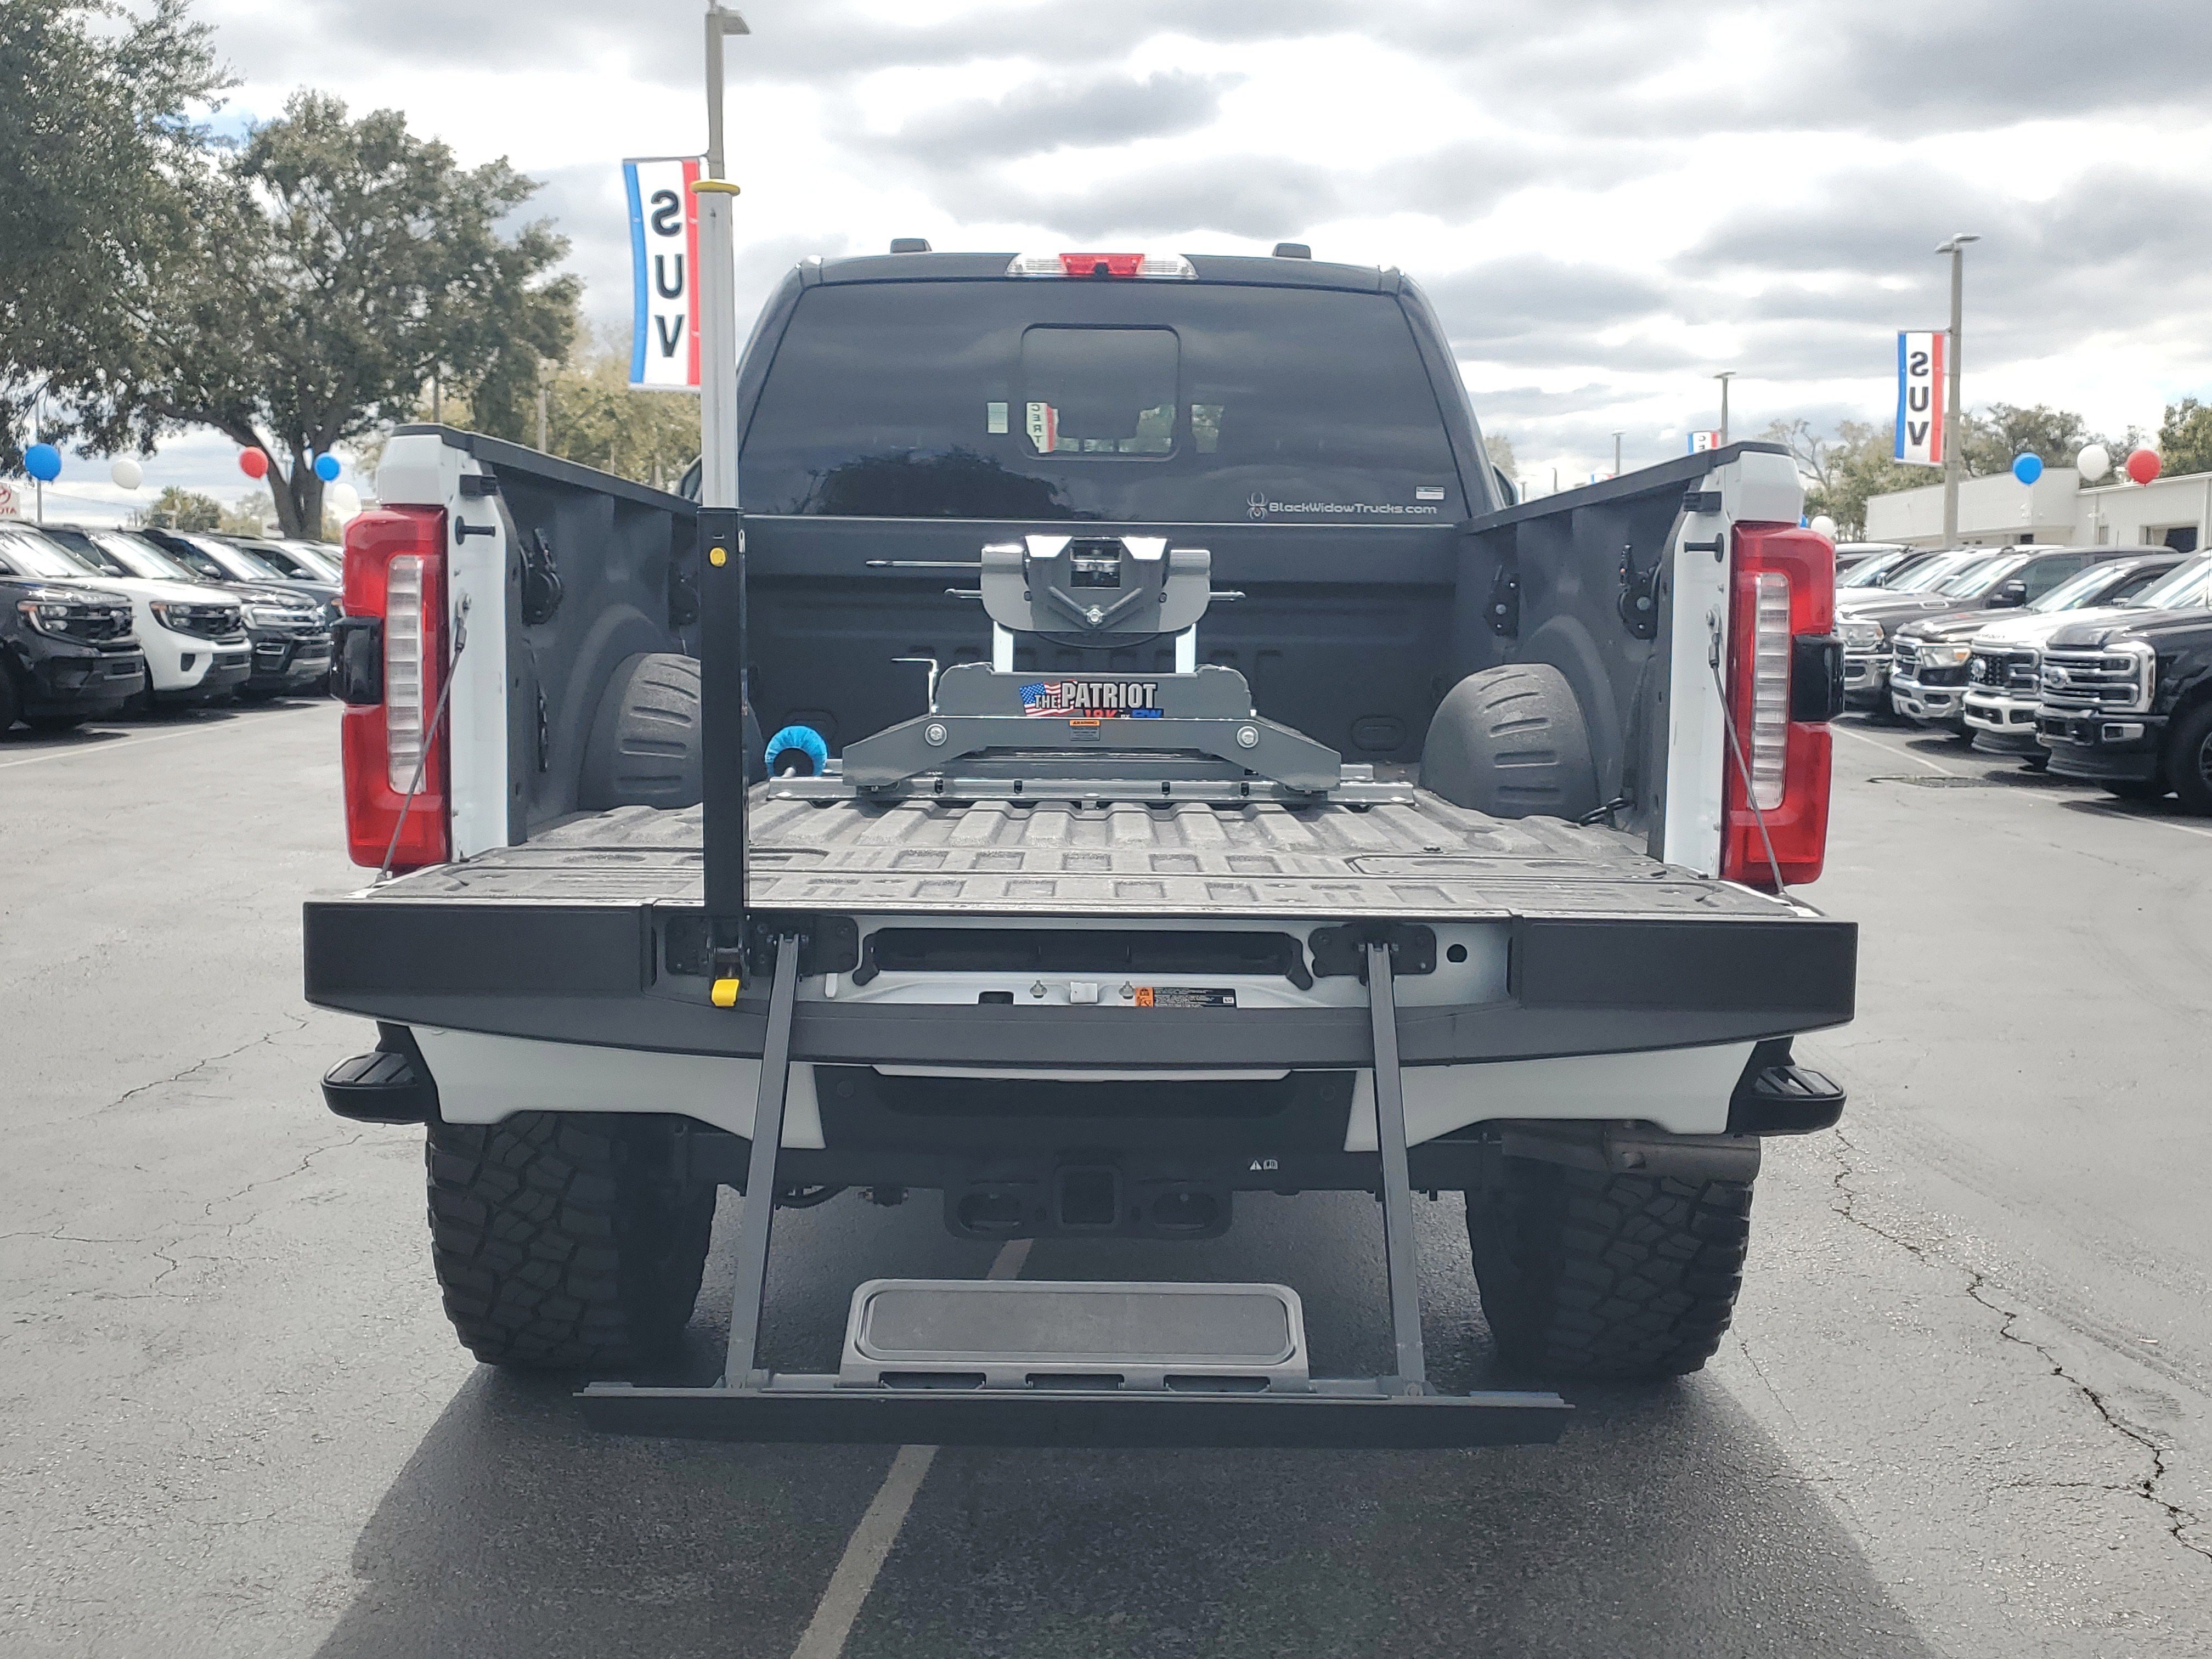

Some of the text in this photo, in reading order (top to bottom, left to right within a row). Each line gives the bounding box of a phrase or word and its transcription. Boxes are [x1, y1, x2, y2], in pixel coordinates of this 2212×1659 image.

[1268, 502, 1437, 514] BlackWidowTrucks.com
[1035, 681, 1157, 709] THE PATRIOT
